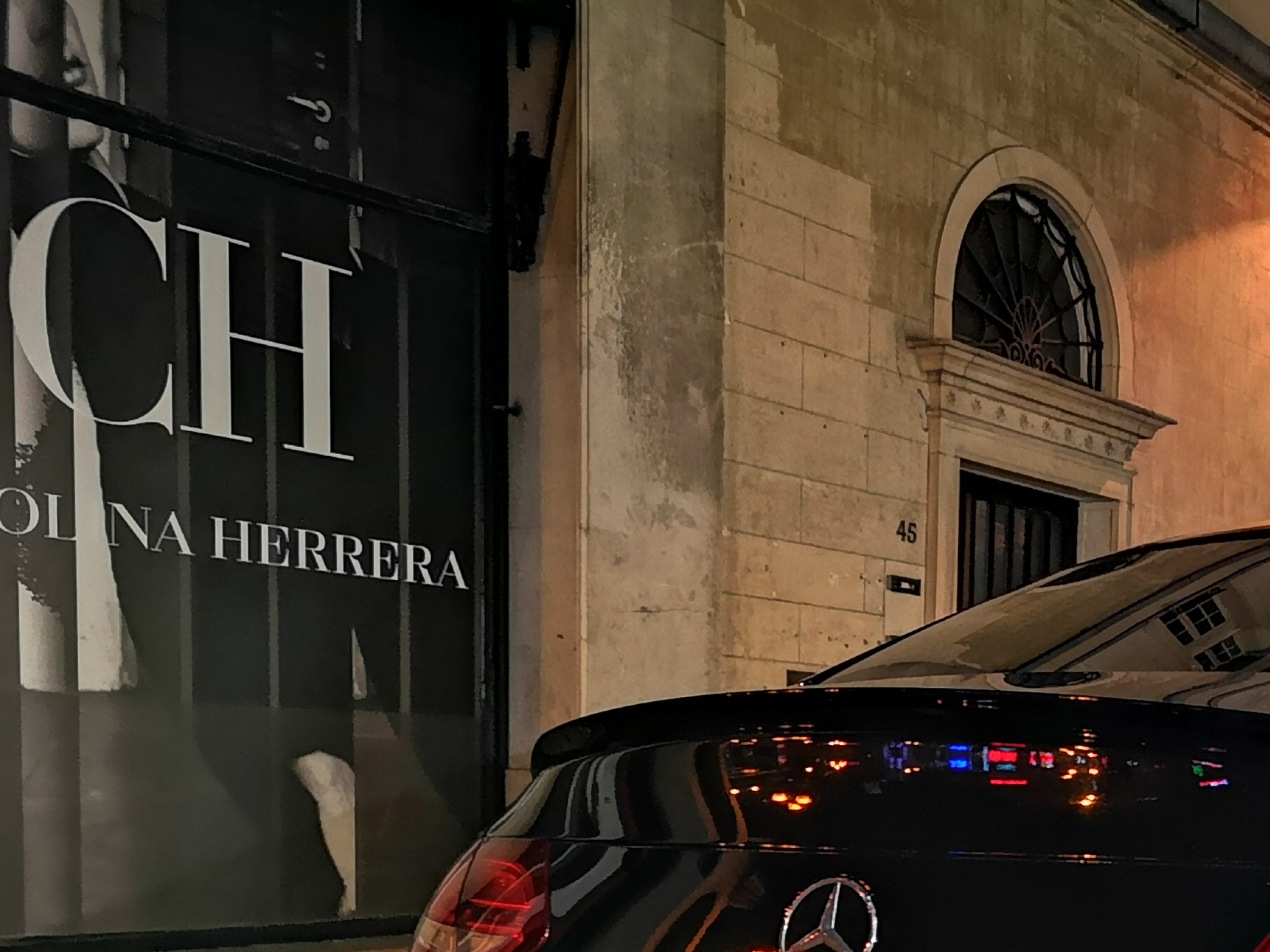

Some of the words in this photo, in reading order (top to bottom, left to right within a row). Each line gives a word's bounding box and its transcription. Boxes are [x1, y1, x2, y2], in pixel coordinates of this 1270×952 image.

[10, 197, 354, 461] CH
[209, 516, 470, 590] HERRERA
[896, 520, 917, 544] 45
